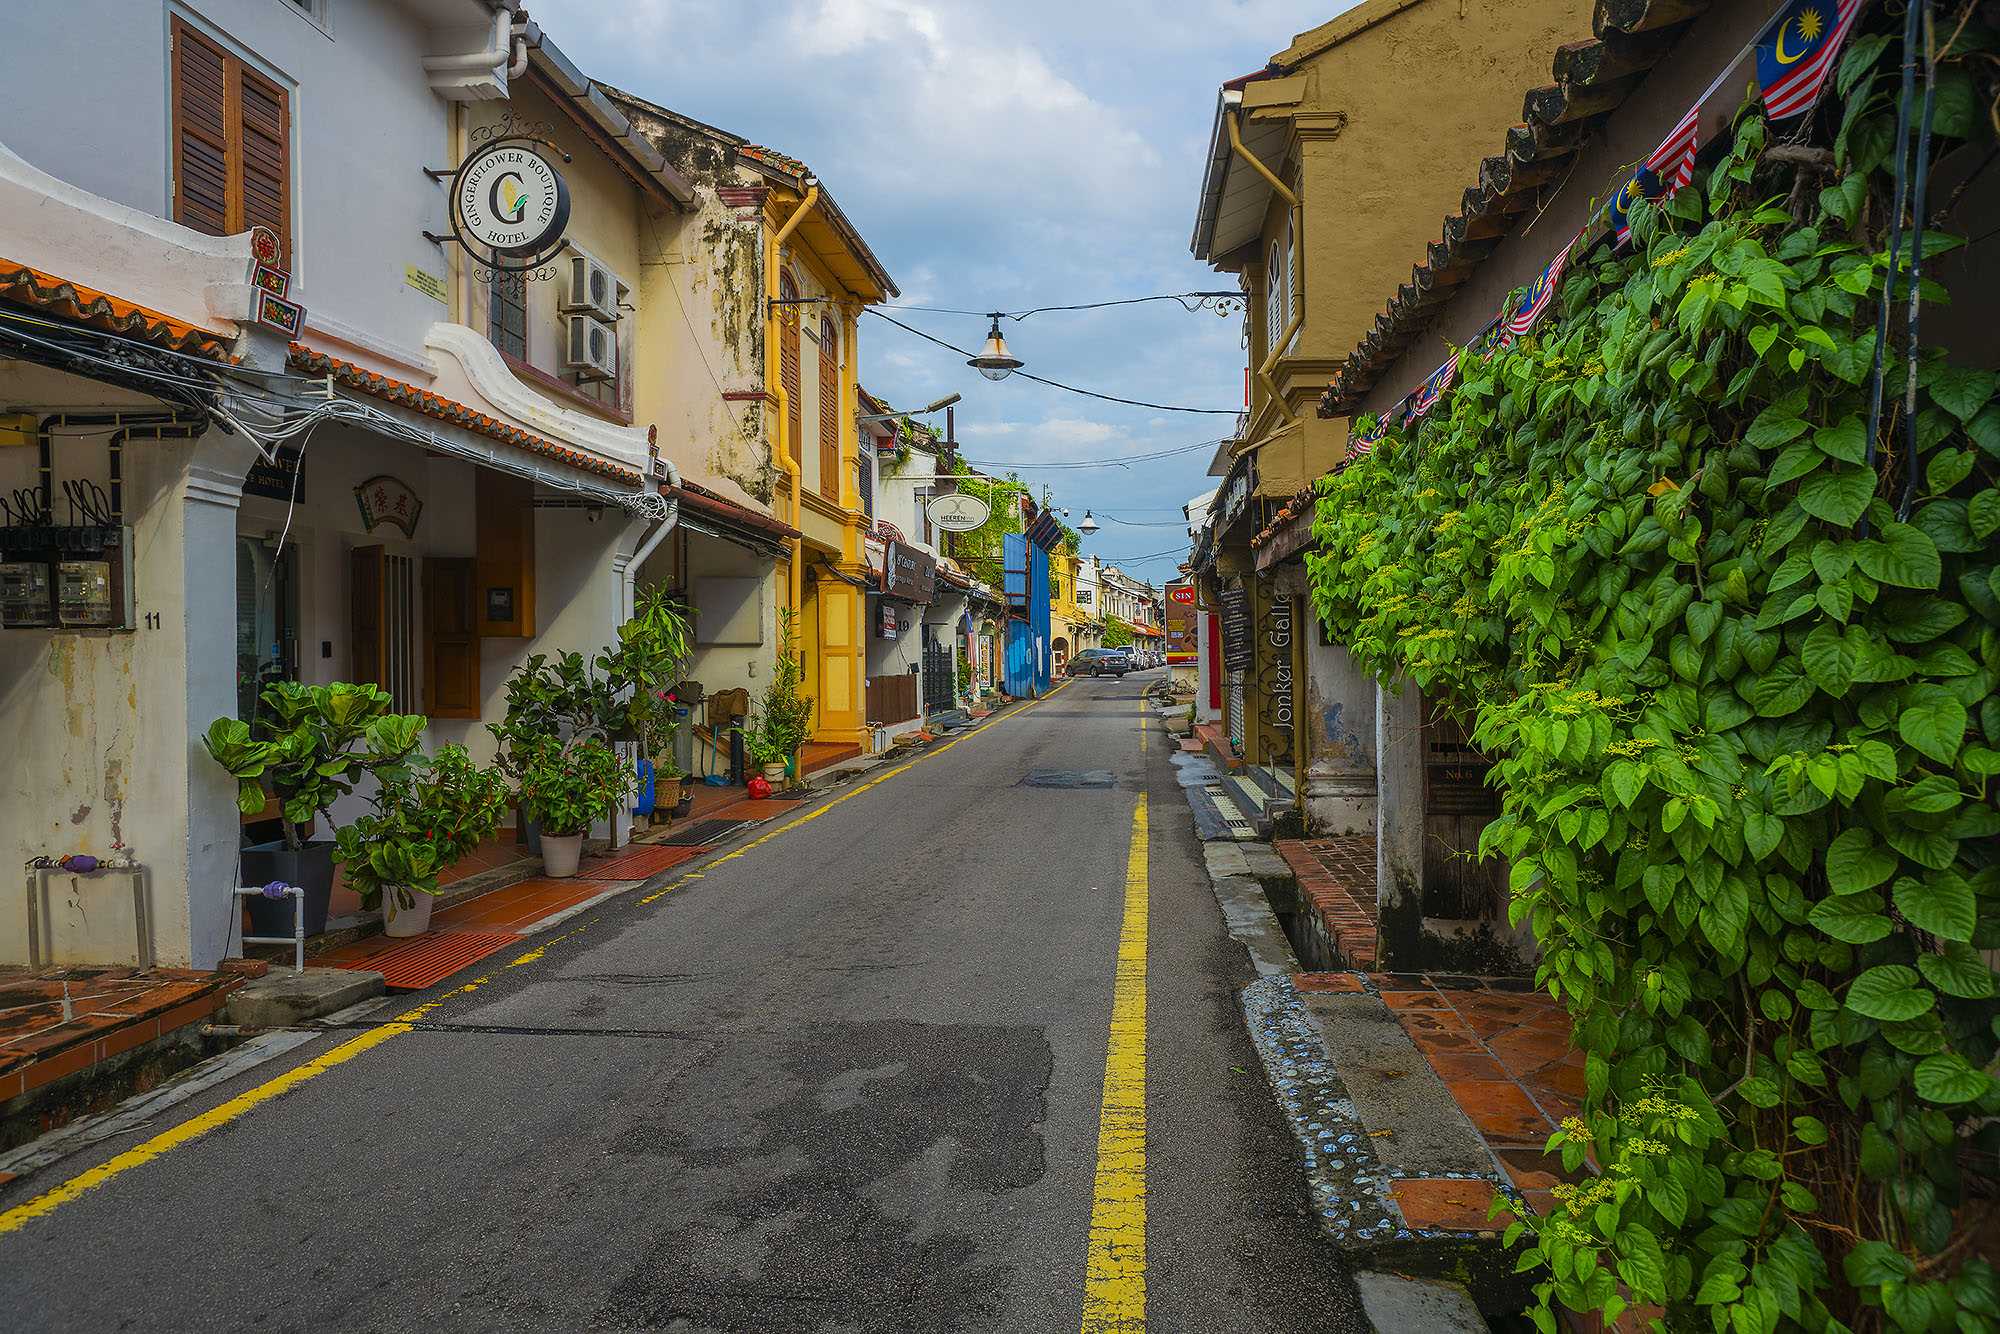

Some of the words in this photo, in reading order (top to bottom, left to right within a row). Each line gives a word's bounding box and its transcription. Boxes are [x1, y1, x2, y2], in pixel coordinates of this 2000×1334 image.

[465, 153, 523, 227] GINGERFLOWER
[528, 159, 554, 224] BOUTIQUE
[487, 231, 529, 244] HOTEL
[1175, 592, 1191, 600] SIN
[145, 612, 161, 630] 11
[897, 620, 910, 632] 19
[1272, 660, 1294, 730] Jonker
